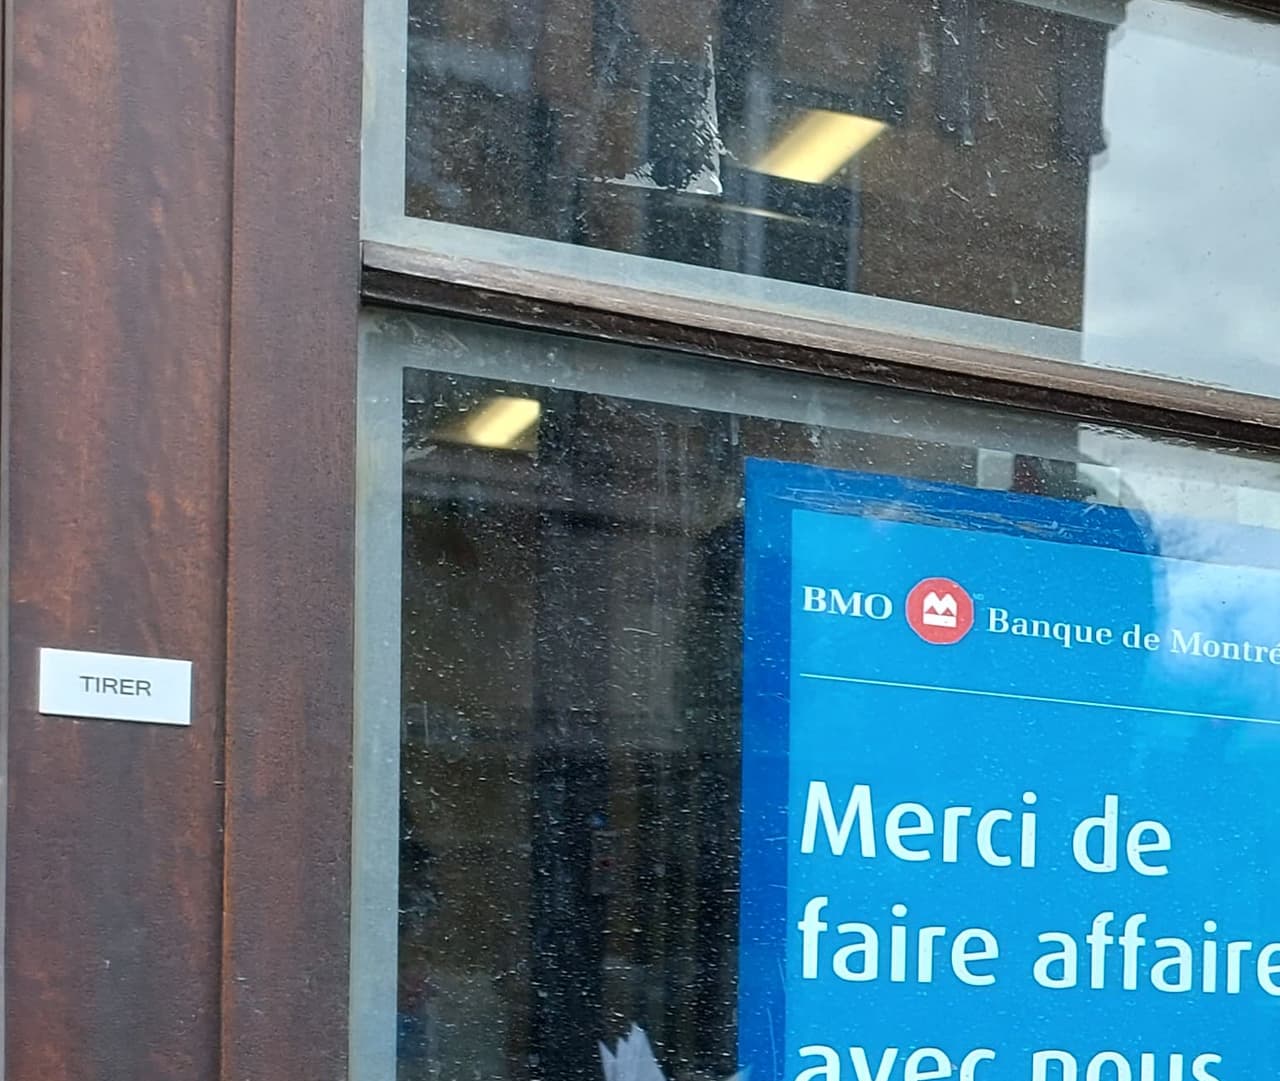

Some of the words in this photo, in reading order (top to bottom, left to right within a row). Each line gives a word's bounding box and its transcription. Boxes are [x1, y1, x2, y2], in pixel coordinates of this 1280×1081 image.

[801, 585, 894, 621] BMO
[988, 606, 1113, 649] Banque
[1122, 624, 1160, 651] de
[79, 675, 152, 697] TIRER
[801, 781, 1037, 868] Merci
[1072, 794, 1171, 876] de
[797, 896, 999, 986] faire
